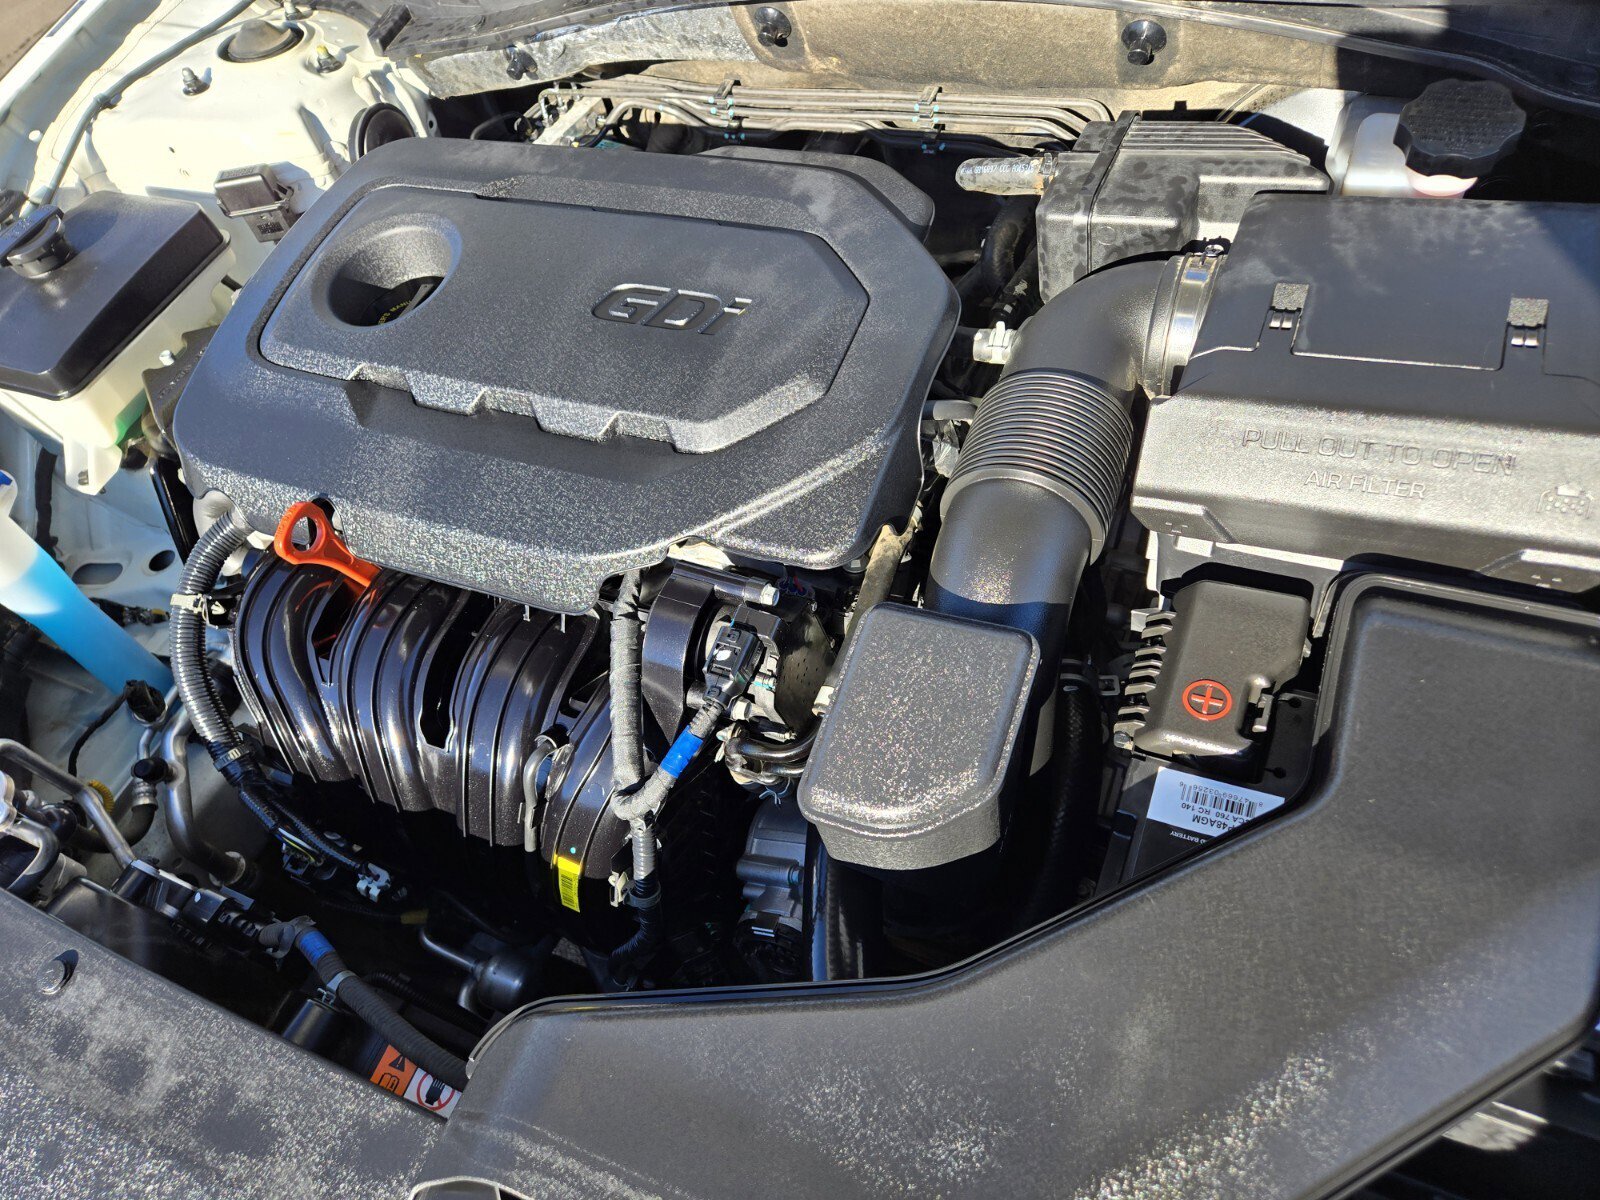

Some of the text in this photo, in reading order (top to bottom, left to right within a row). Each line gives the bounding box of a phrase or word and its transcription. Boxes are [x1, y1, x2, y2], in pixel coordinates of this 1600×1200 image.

[1241, 429, 1517, 476] PULL OUT TO OPEN
[1303, 469, 1426, 499] AIR FILTER
[1181, 802, 1196, 811] 140
[1198, 807, 1211, 815] RC
[1215, 811, 1230, 821] 760
[1170, 830, 1199, 843] BATTERY
